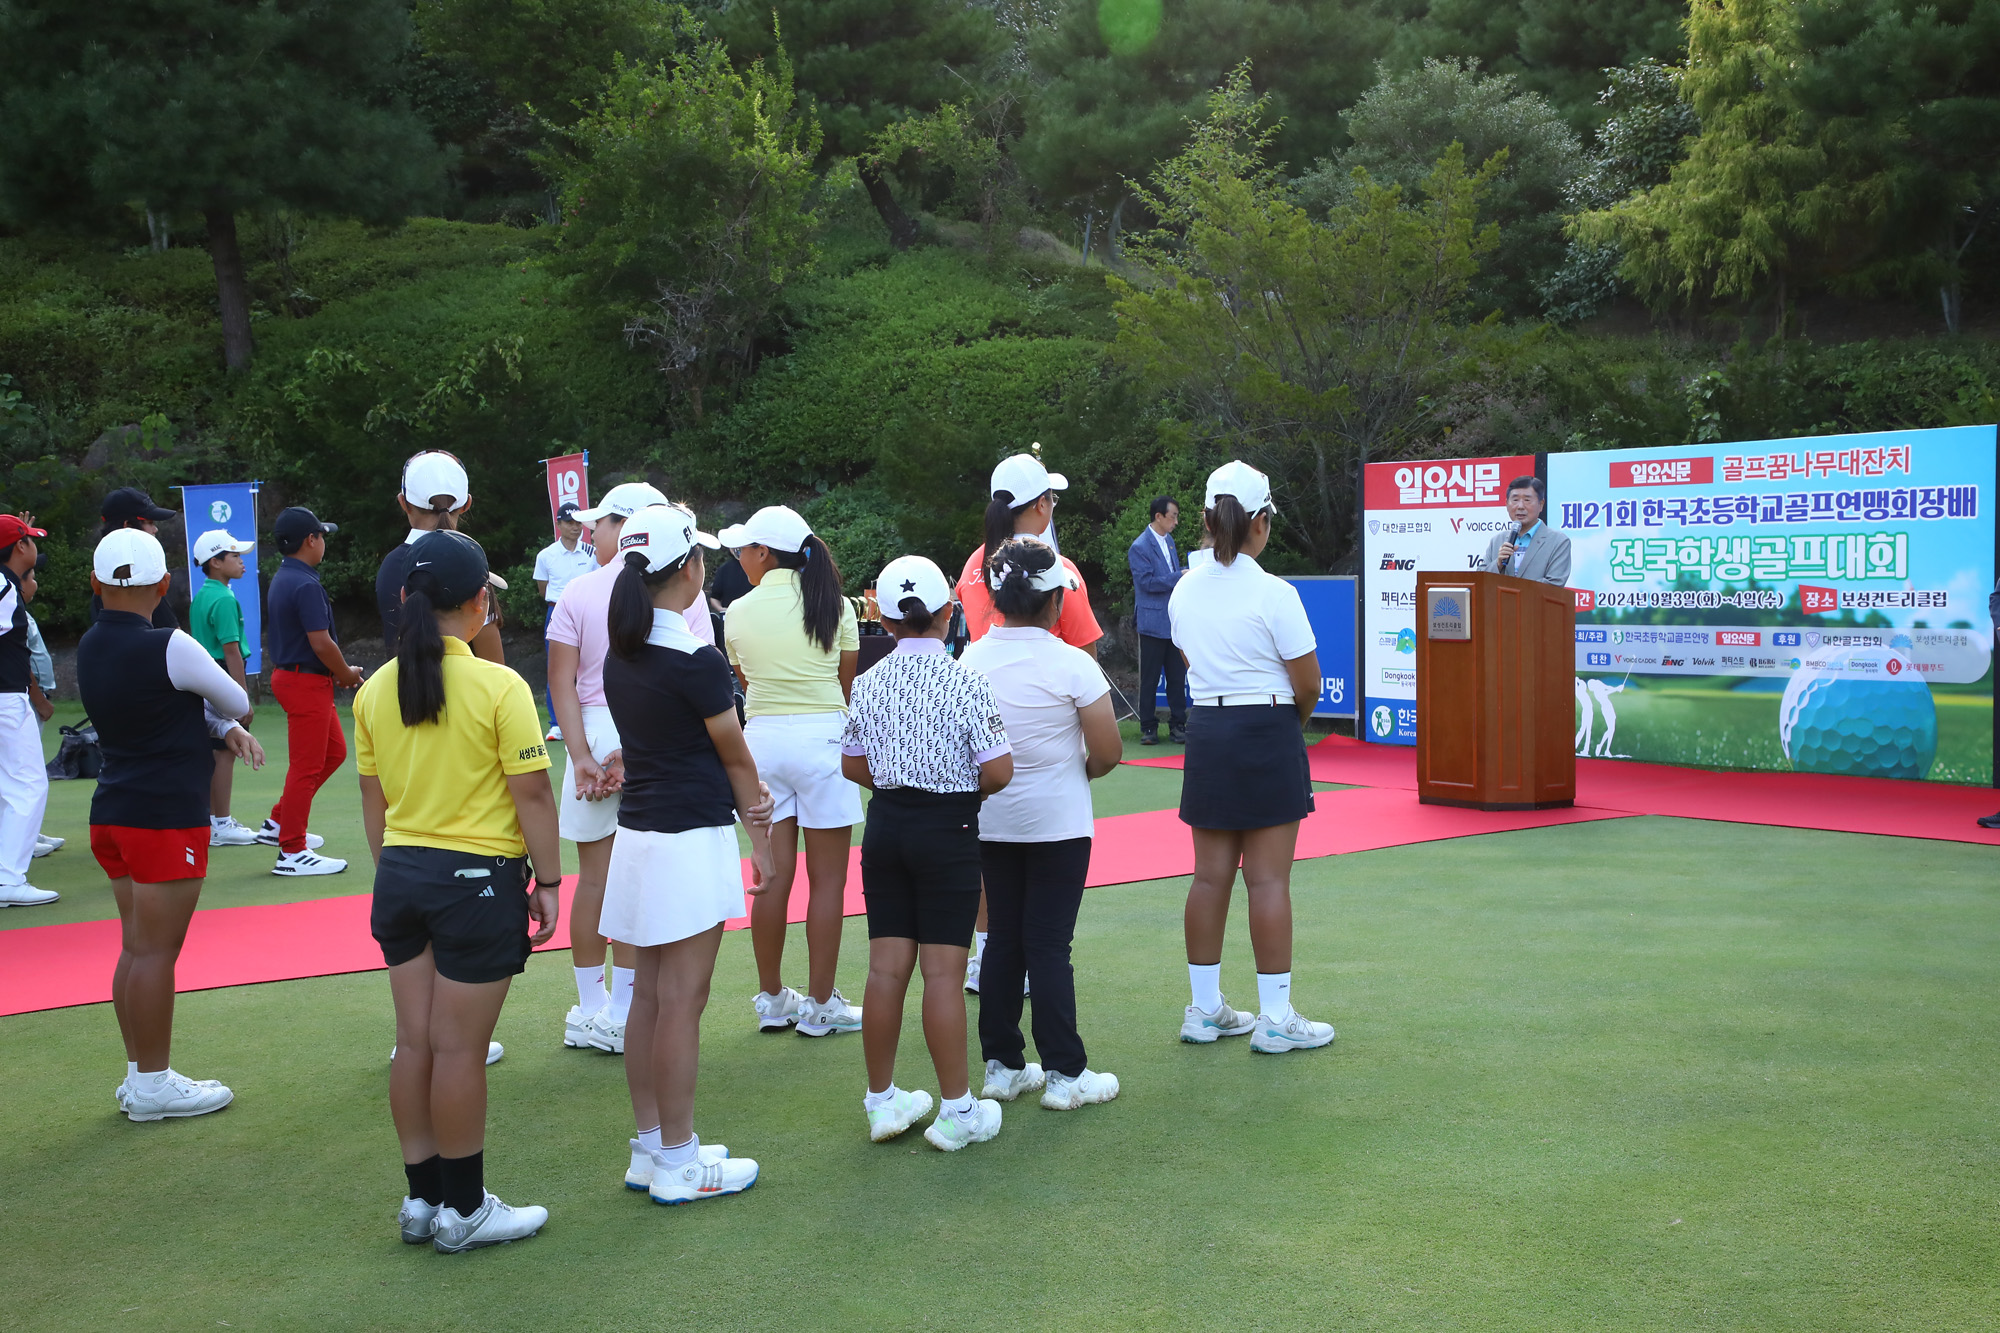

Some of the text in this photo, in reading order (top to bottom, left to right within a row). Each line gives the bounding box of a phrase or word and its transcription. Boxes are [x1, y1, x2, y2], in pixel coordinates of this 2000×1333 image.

[1630, 446, 1911, 484] 일요신문 골프꿈나무대잔치
[1394, 463, 1500, 505] 일요신문
[1561, 486, 1977, 529] 제21회 한국초등학교골프연맹회장배
[1383, 522, 1432, 533] 대한골프협회
[1466, 521, 1513, 532] VOICE CAD
[1611, 531, 1909, 583] 전국학생골프대회
[1598, 592, 1647, 607] 2024년
[1805, 591, 1948, 609] 장소 보성컨트리클럽
[1625, 632, 1710, 644] 한국초등학교골프연맹
[1721, 633, 1755, 645] 일요신문
[1823, 636, 1883, 647] 대한골프협회
[1916, 635, 1968, 646] 보성컨트리클럽
[1692, 657, 1716, 666] Volvik
[1851, 661, 1878, 669] Dongkook
[1384, 672, 1416, 682] Dongkook
